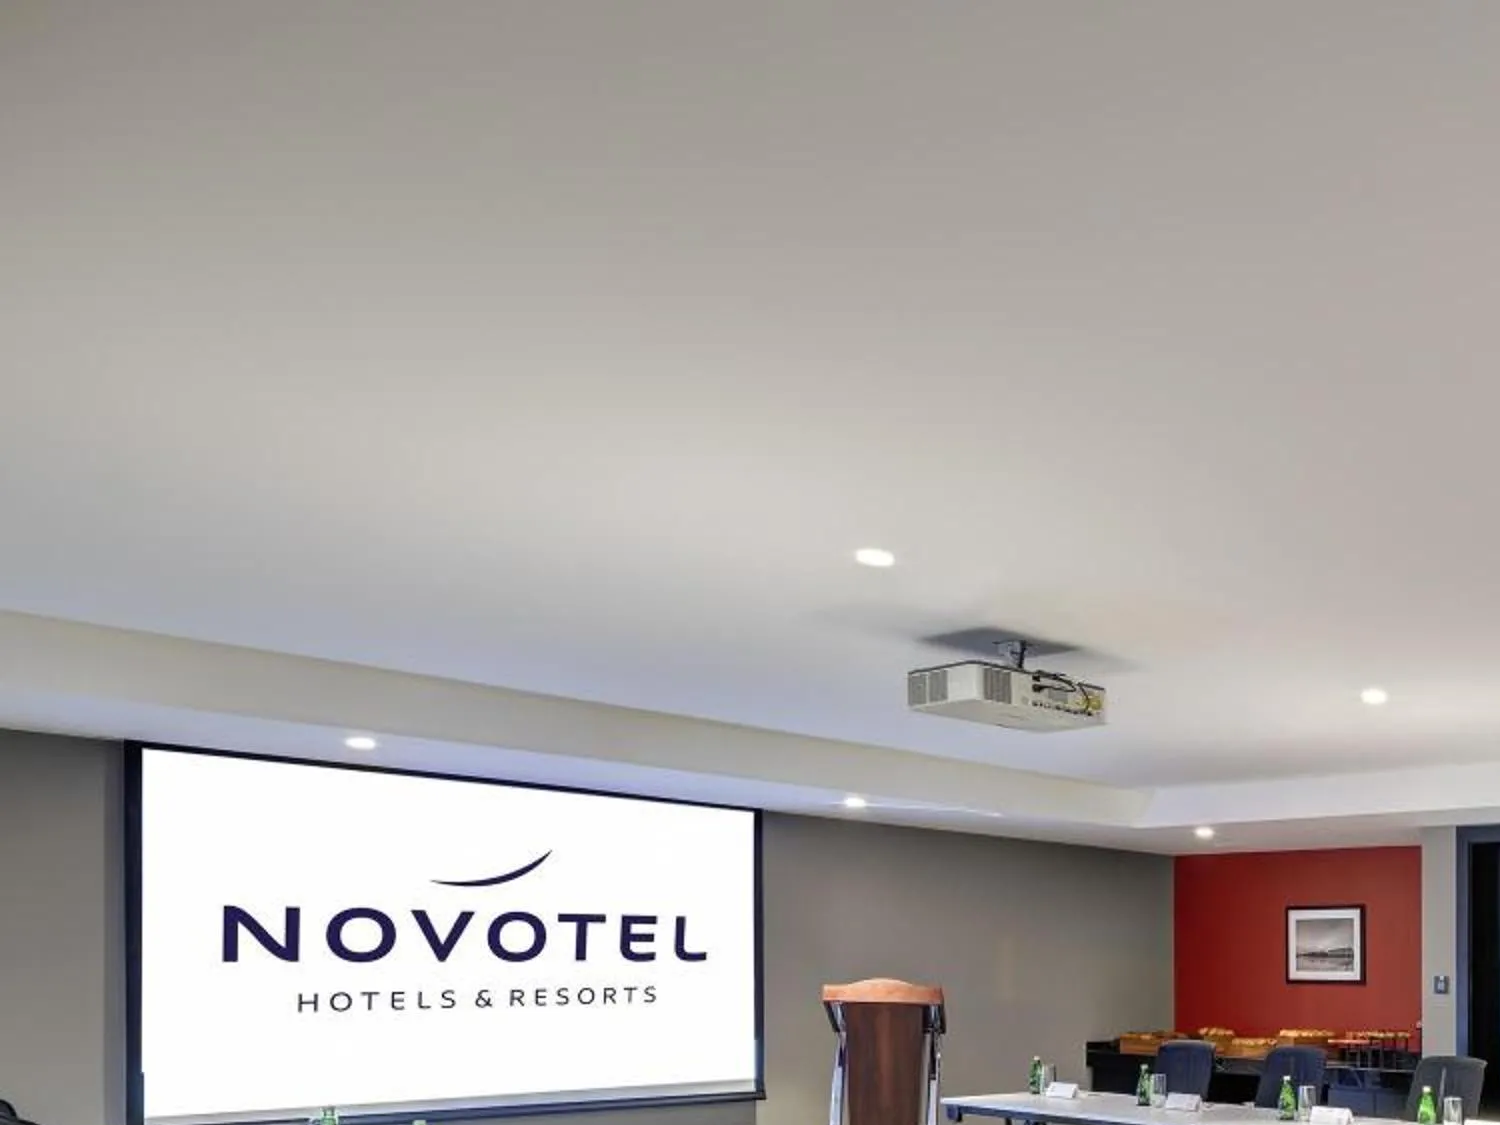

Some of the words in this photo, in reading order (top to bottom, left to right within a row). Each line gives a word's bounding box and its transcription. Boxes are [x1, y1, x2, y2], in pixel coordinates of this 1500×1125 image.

[221, 904, 708, 963] NOVOTEL
[297, 989, 457, 1013] HOTELS
[474, 989, 493, 1009] &
[509, 985, 657, 1007] RESORTS
